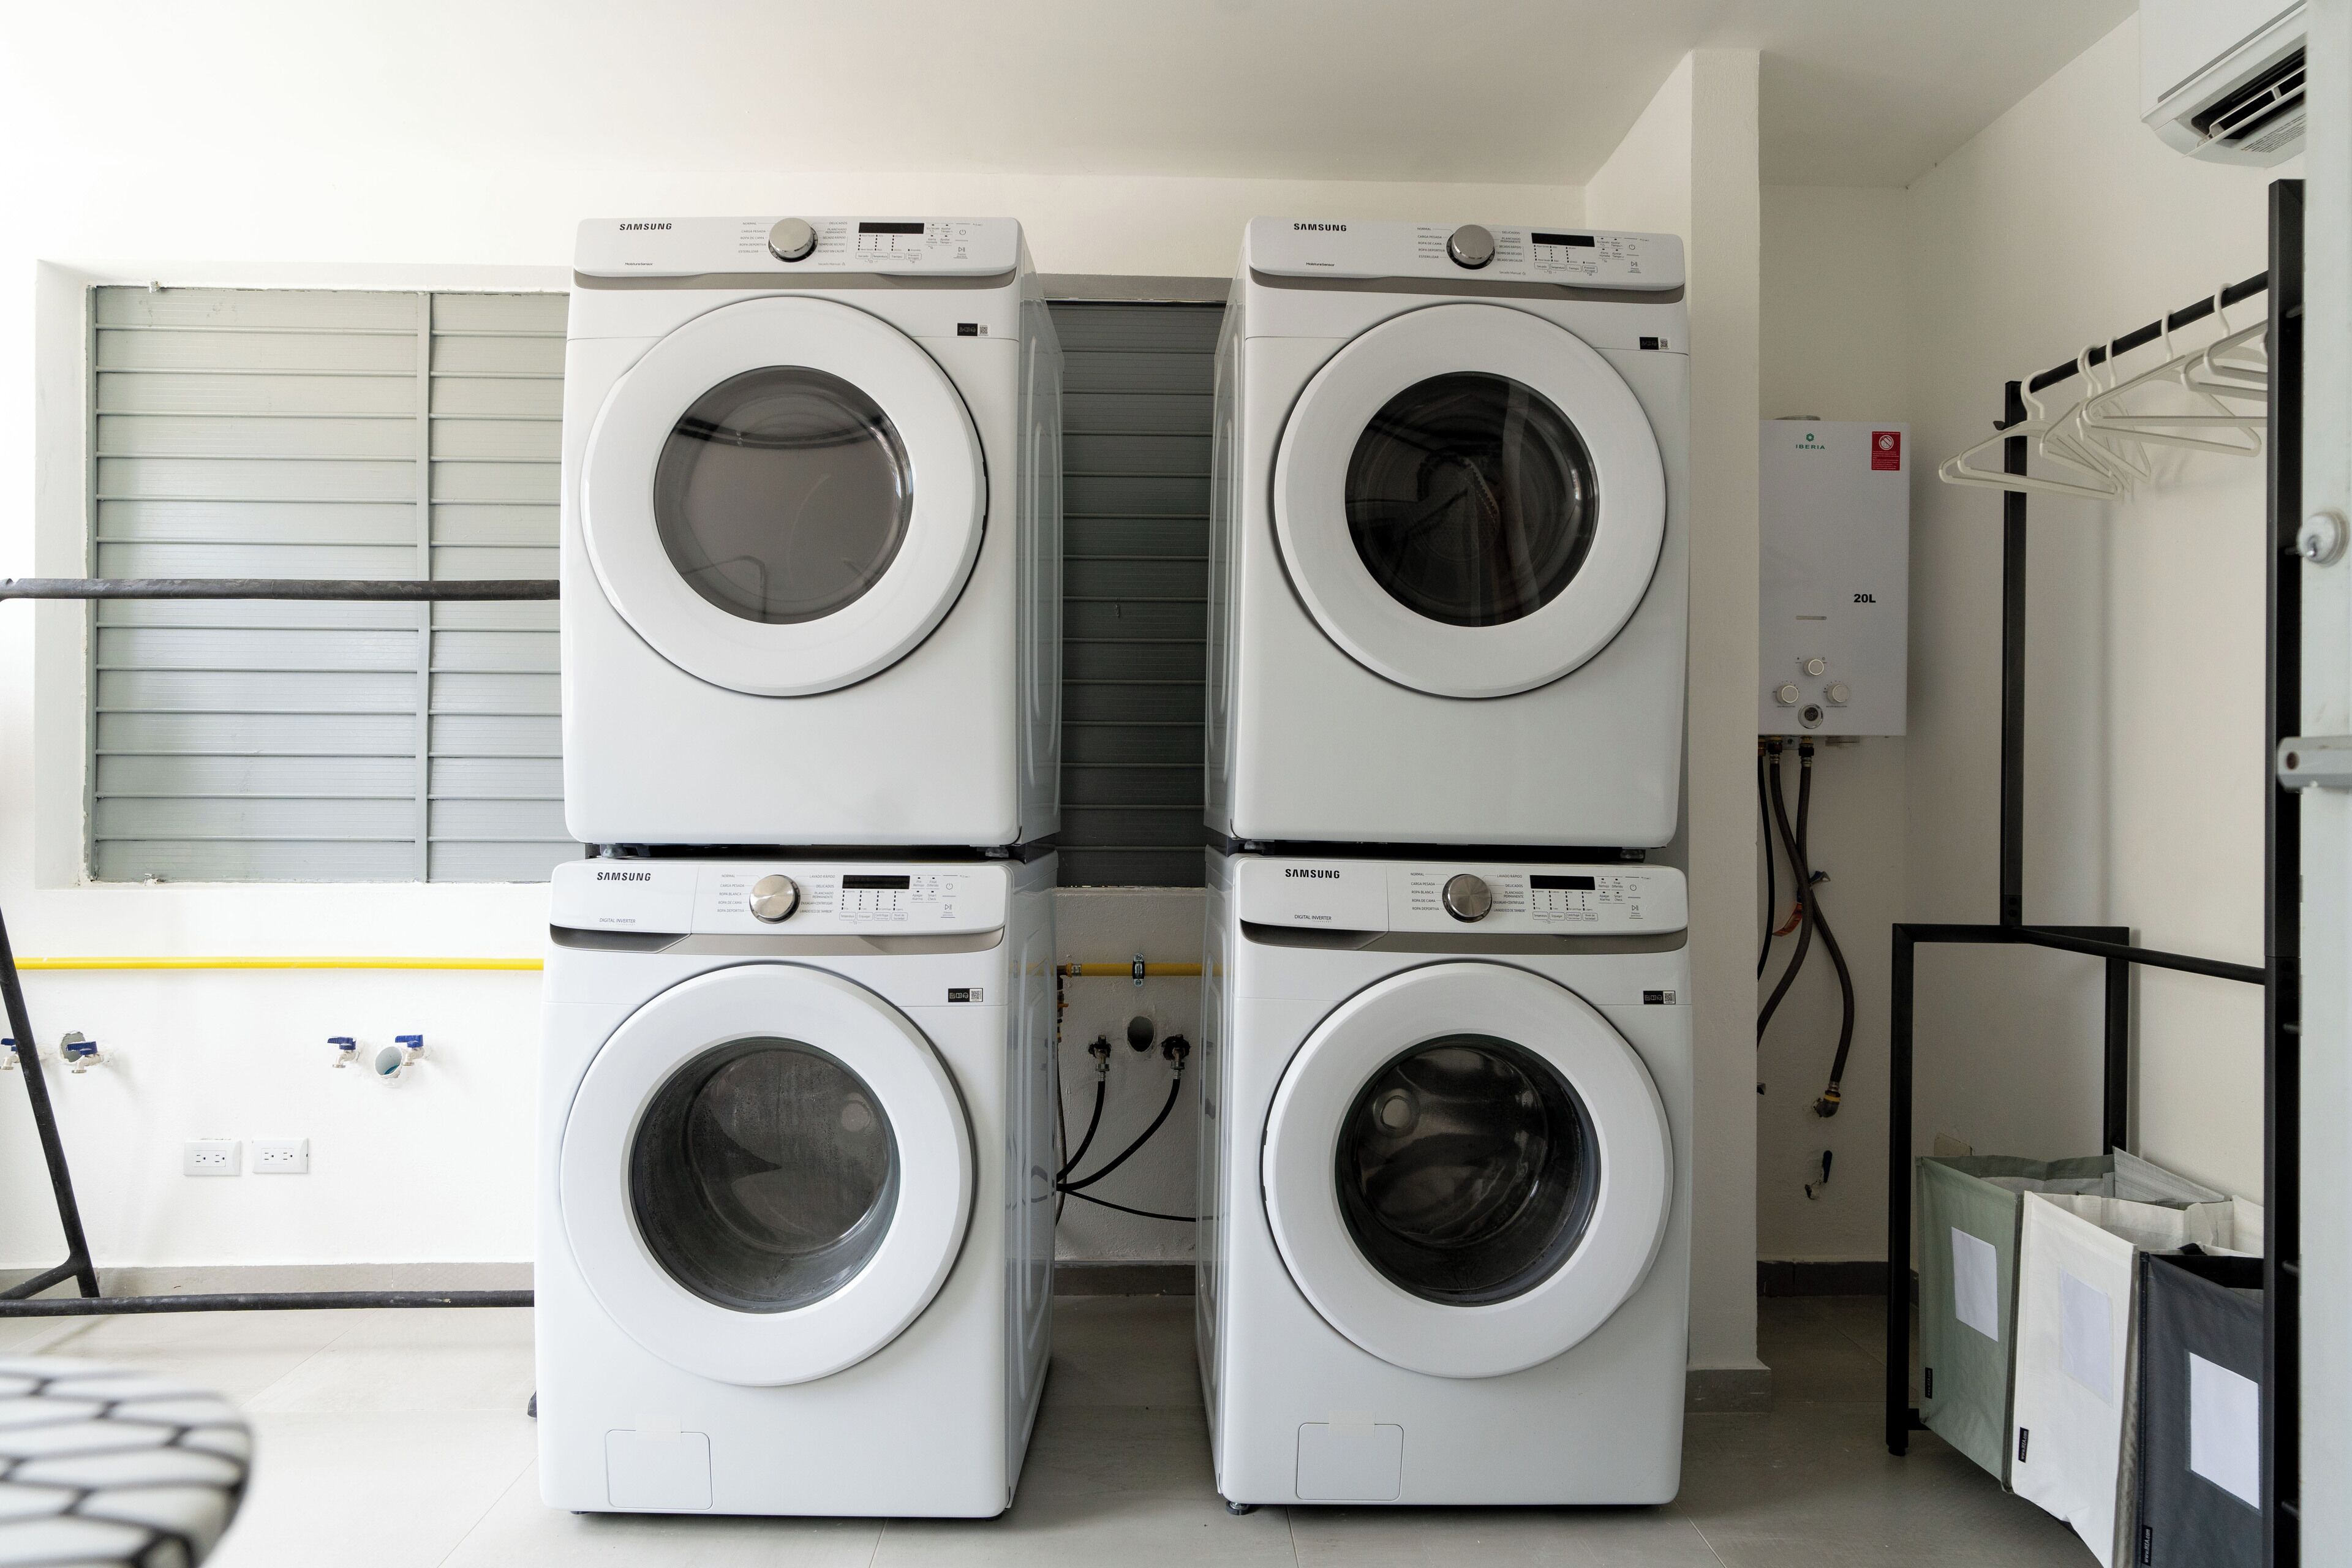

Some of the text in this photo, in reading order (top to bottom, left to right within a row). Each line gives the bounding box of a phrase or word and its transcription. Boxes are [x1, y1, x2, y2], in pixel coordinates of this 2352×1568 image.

[1294, 223, 1347, 232] SAMSUNG
[1854, 594, 1876, 603] 20L
[597, 872, 651, 881] SAMSUNG
[1285, 869, 1340, 879] SAMSUNG
